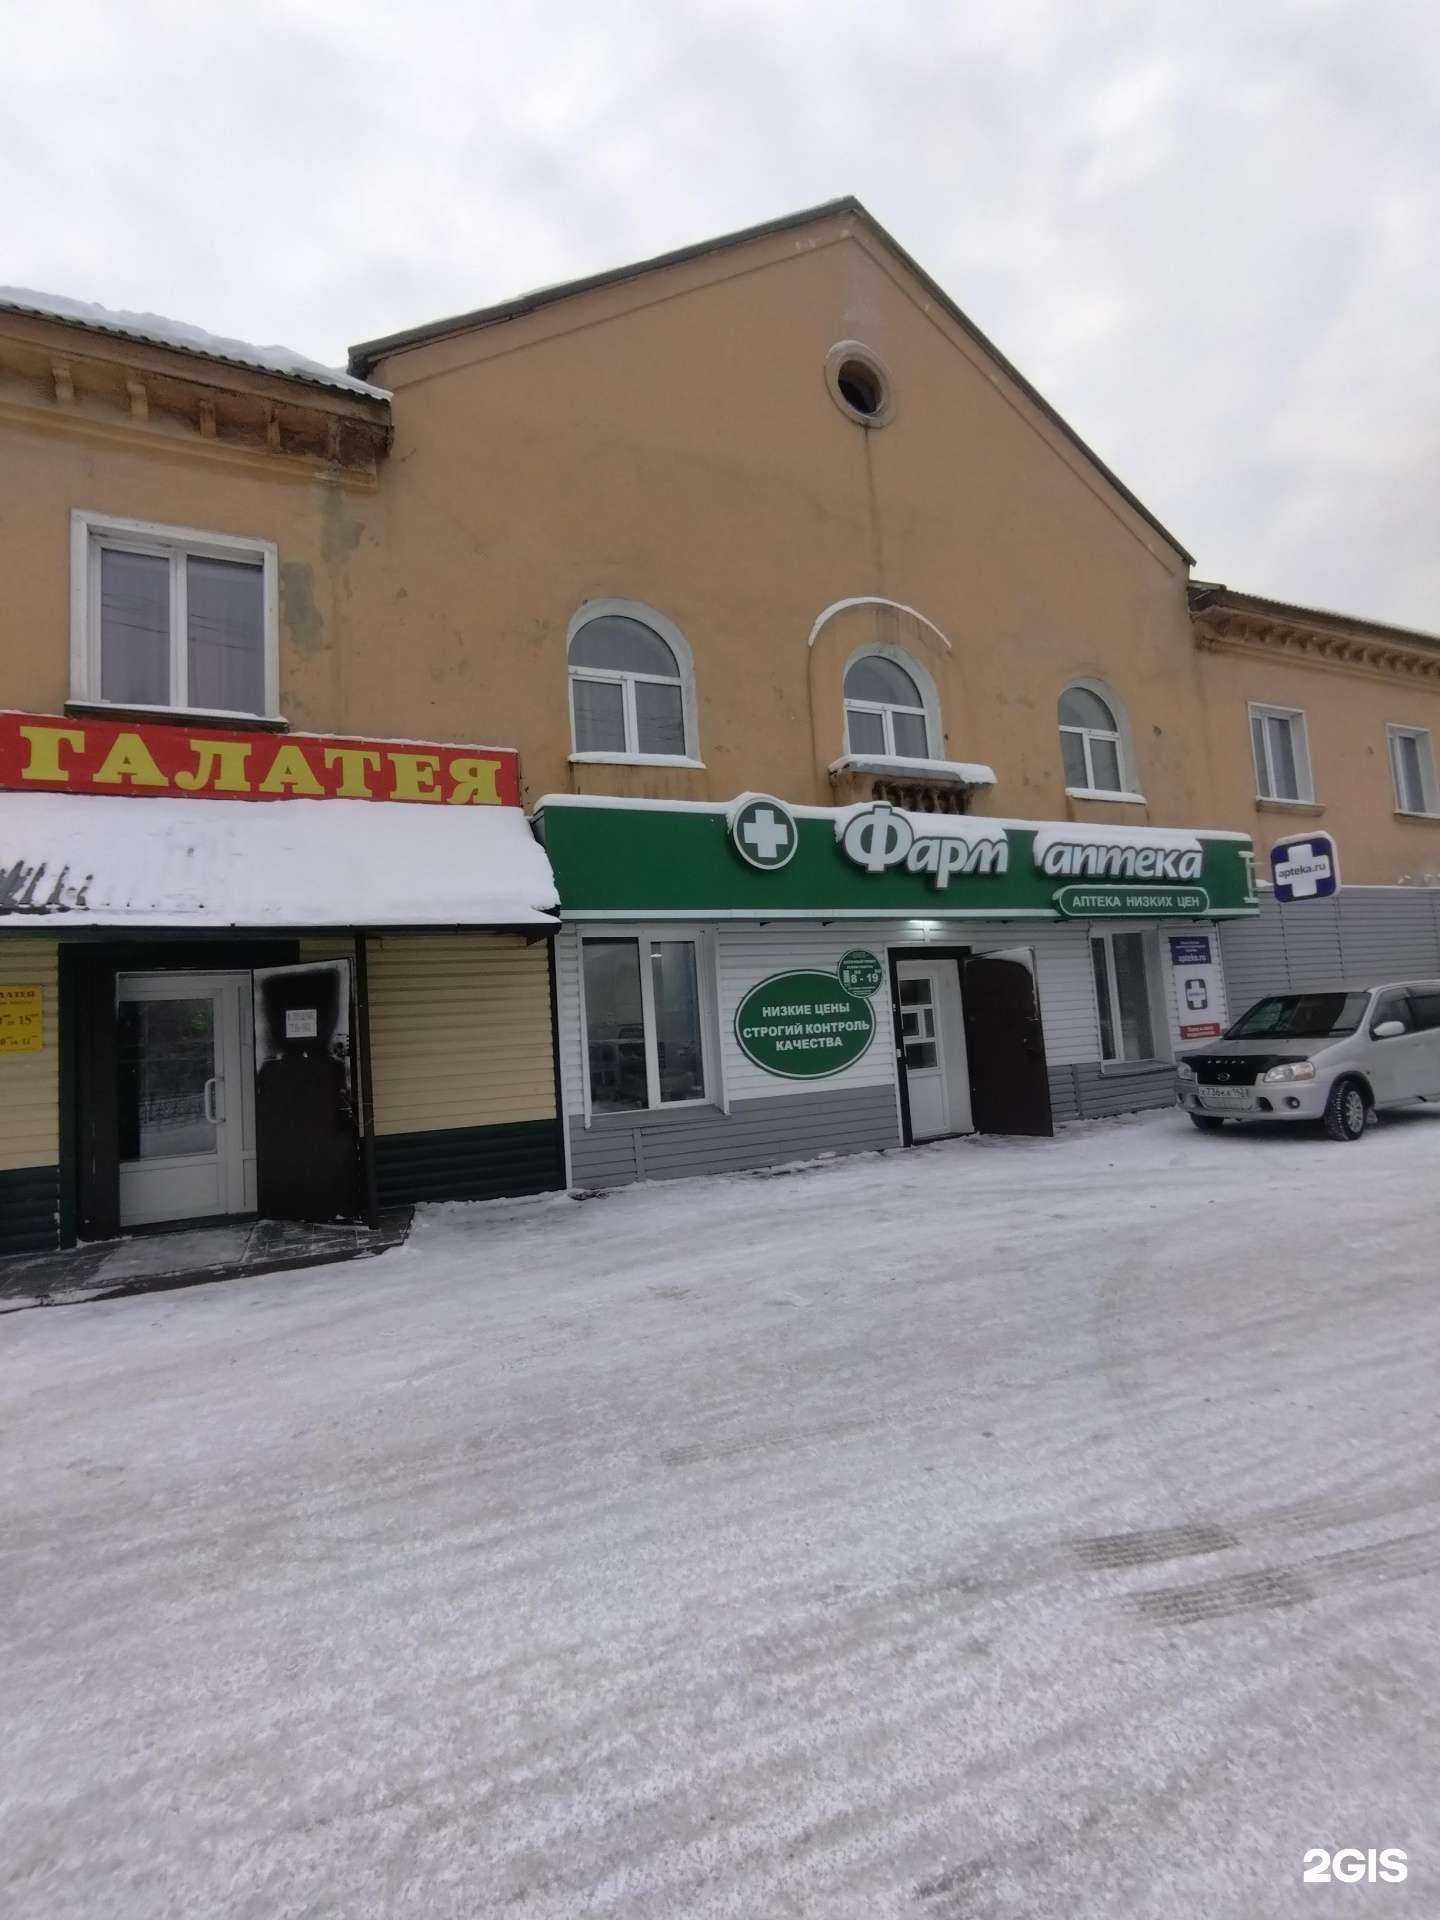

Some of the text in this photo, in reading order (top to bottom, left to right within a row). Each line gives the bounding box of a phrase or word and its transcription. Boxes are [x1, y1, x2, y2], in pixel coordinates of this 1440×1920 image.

[19, 725, 503, 806] ГАЛАТЕЯ
[844, 804, 1203, 888] Фарм аптека
[1278, 863, 1327, 879] apteka.ru
[1072, 896, 1200, 908] АПТЕКА НИЗКИХ ЦЕН
[866, 973, 879, 983] 19
[762, 1002, 850, 1017] НИЗКИЕ ЦЕНЫ
[743, 1020, 870, 1038] СТРОГИЙ КОНТРОЛЬ
[775, 1036, 843, 1051] КАЧЕСТВА
